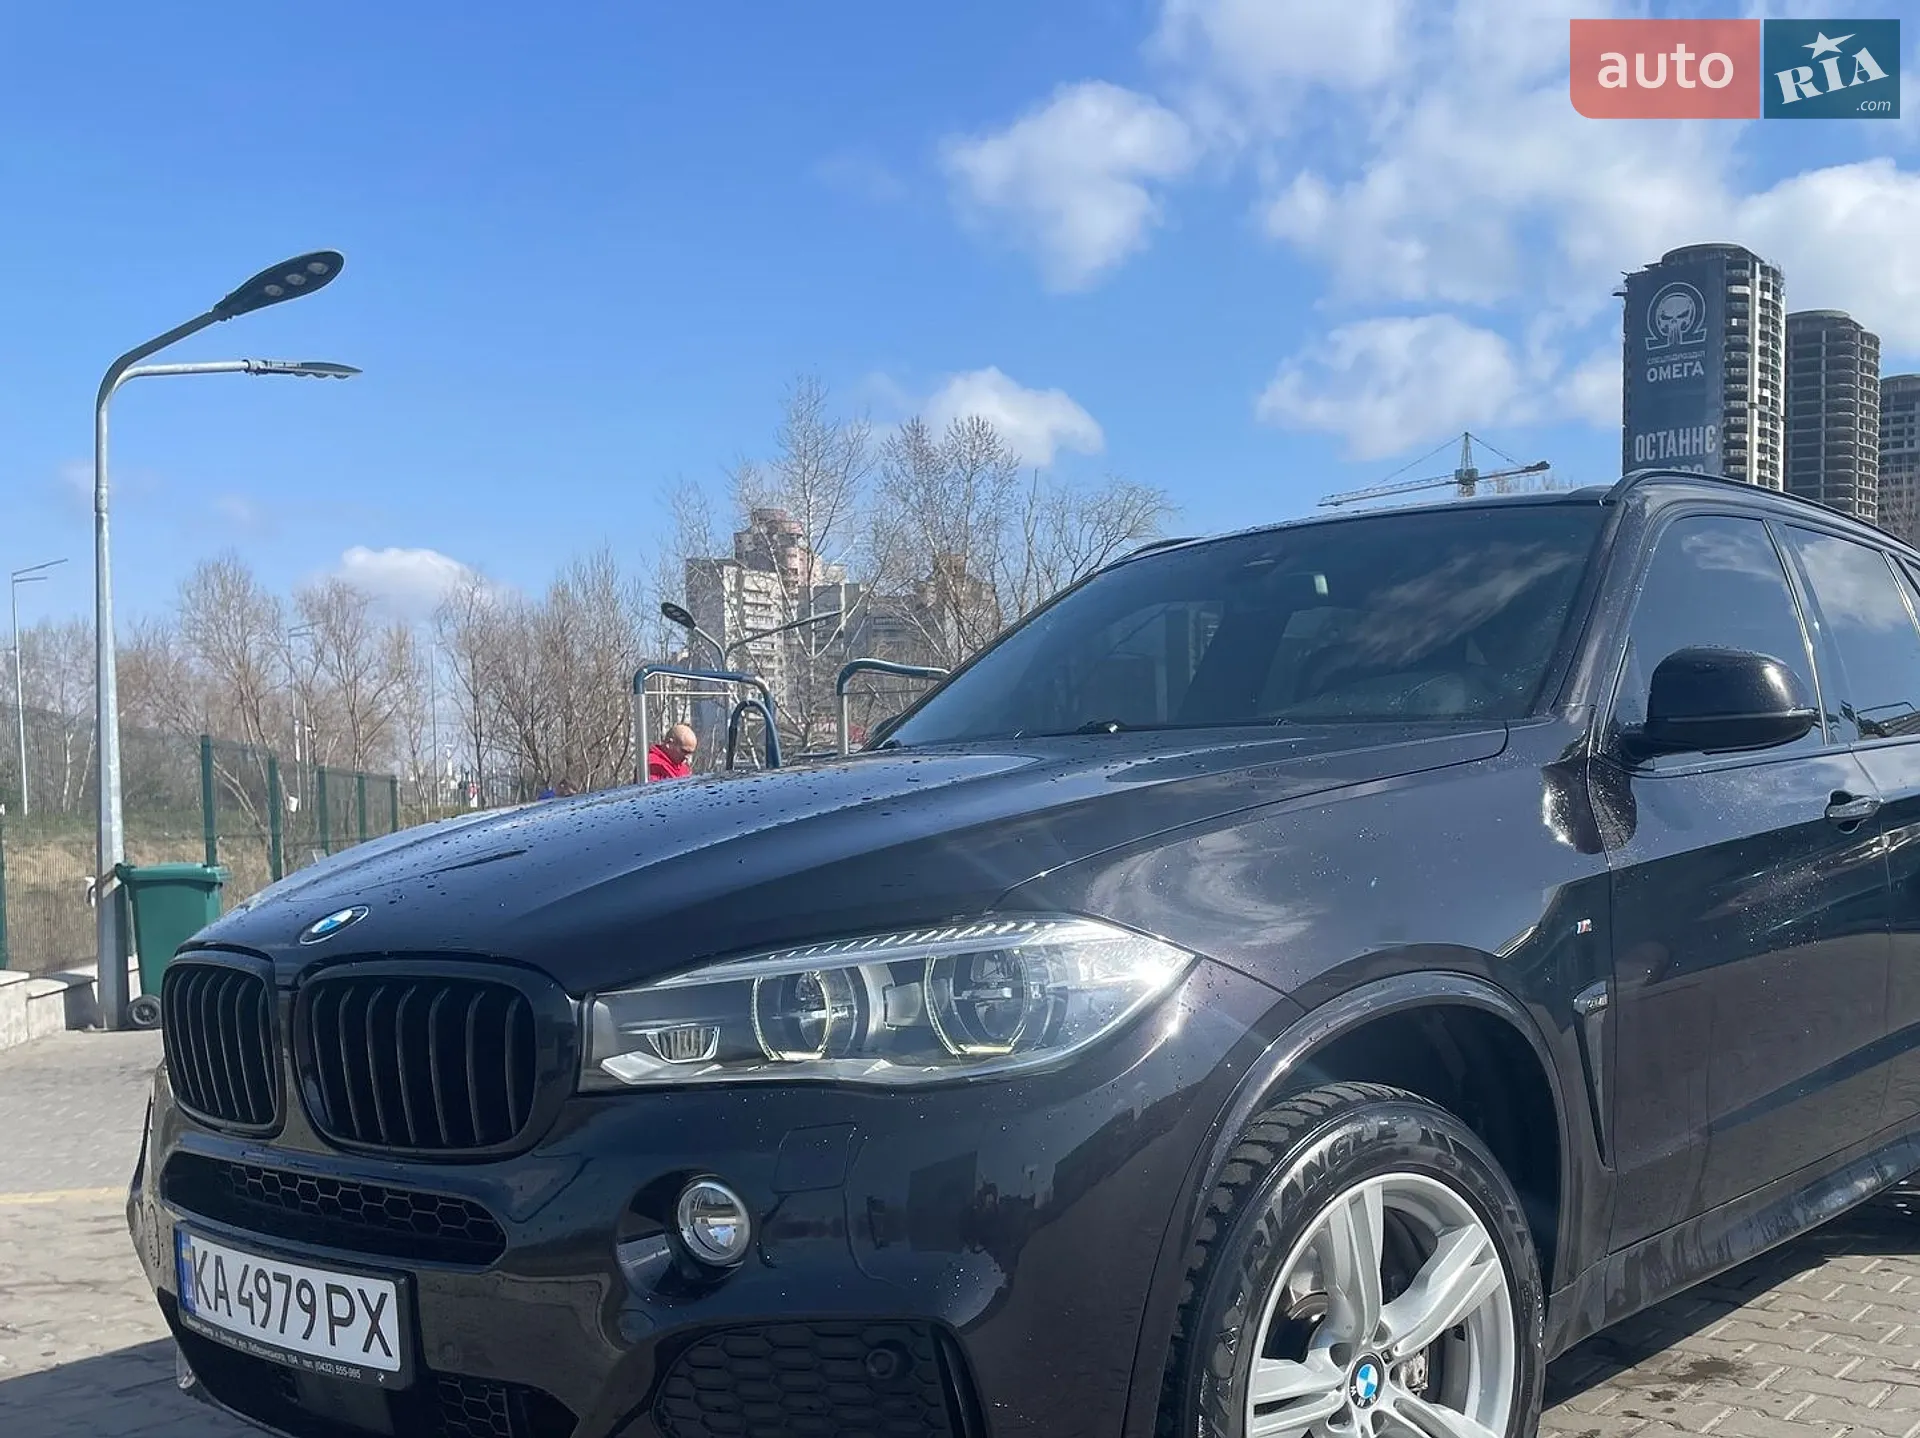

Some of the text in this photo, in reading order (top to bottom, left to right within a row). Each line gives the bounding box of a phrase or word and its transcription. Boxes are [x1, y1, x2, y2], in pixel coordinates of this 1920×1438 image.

[1647, 360, 1705, 383] ОМЕГА
[1635, 424, 1716, 463] ОСТАННЄ
[192, 1245, 233, 1318] KA
[237, 1264, 317, 1341] 4979
[325, 1283, 393, 1358] PX
